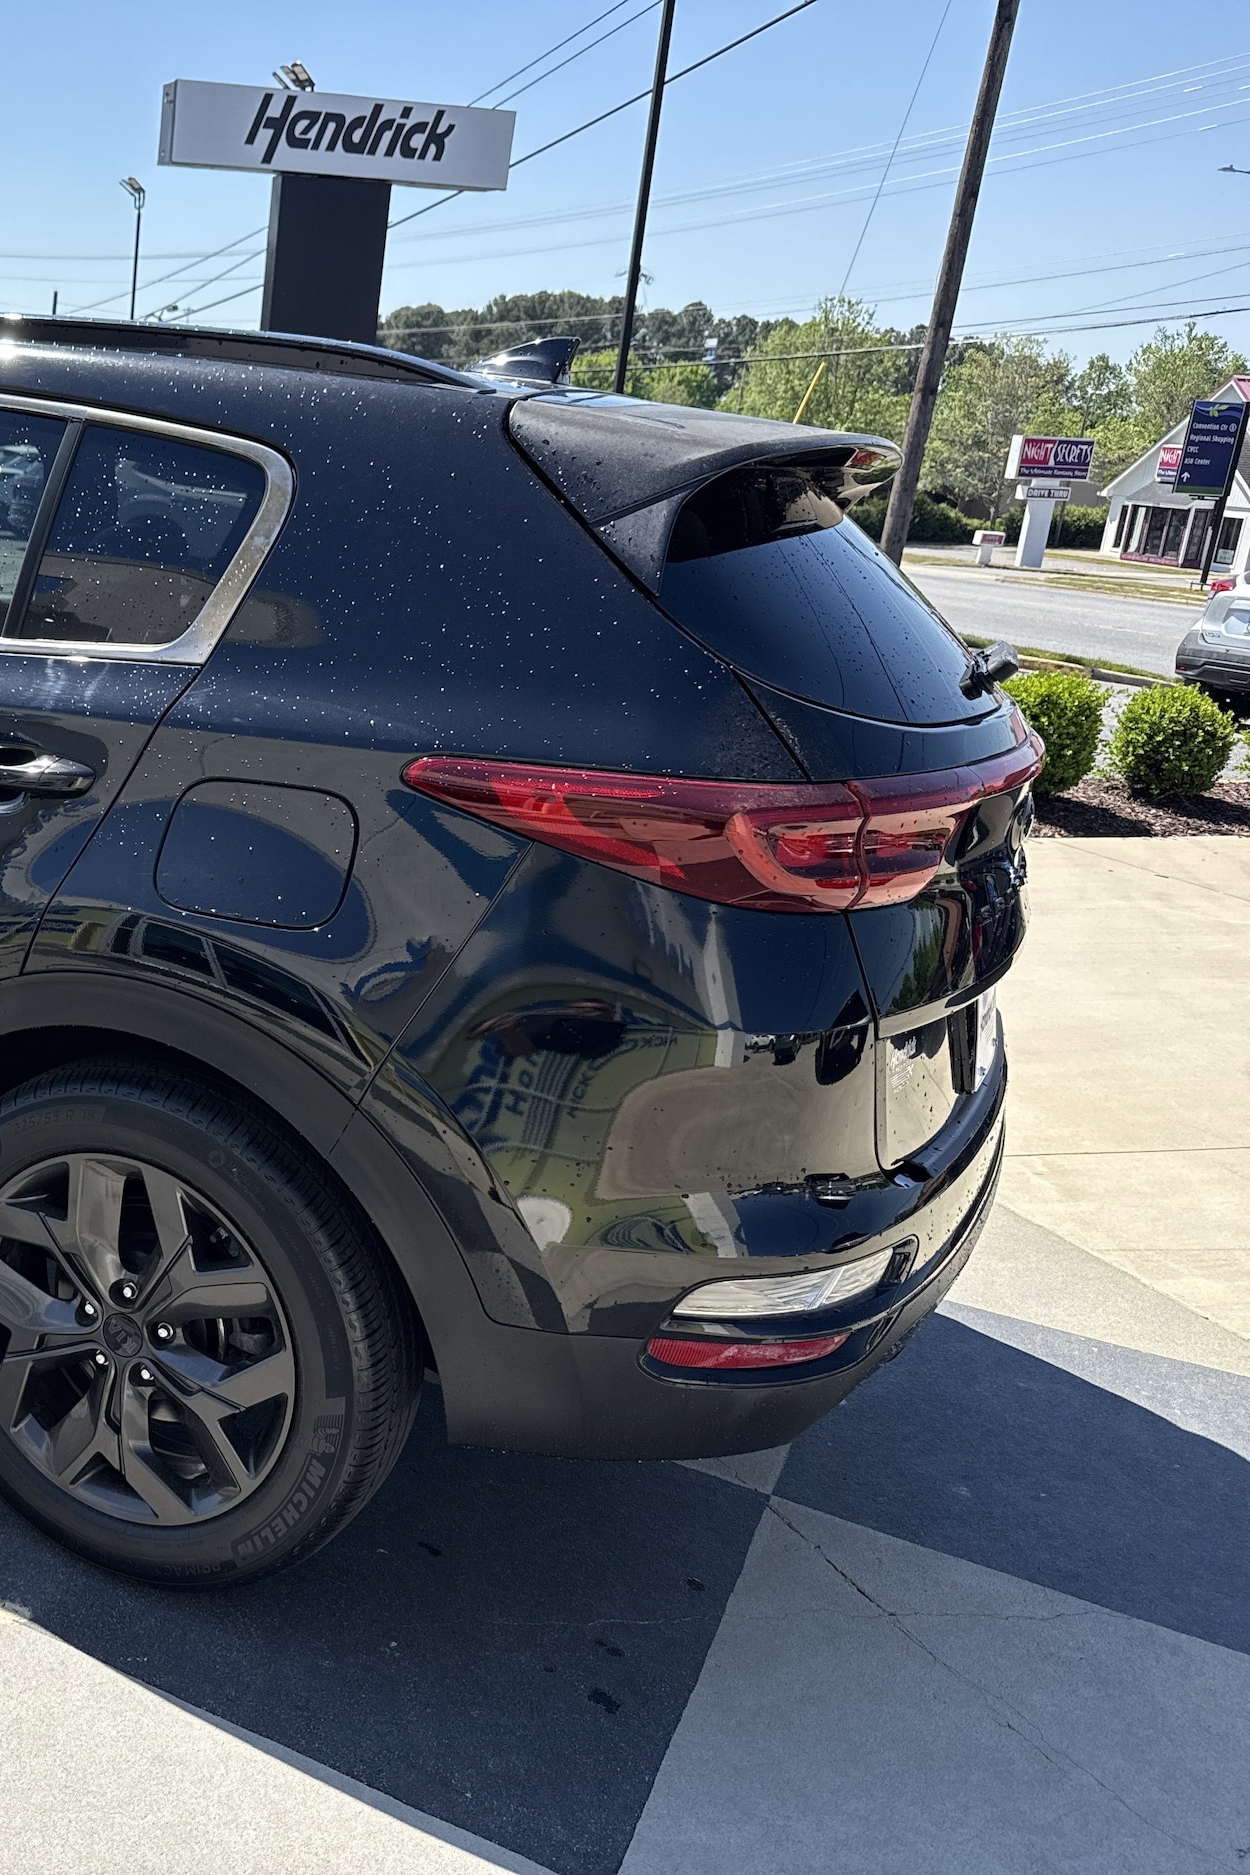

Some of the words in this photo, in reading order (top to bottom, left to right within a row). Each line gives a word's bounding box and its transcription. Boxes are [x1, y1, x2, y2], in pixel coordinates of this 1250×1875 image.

[244, 92, 456, 165] Hendrick
[1192, 422, 1220, 431] Convention
[1190, 433, 1211, 443] Regional
[1212, 435, 1235, 445] Shopping
[1056, 444, 1093, 464] SECRETS
[1027, 489, 1048, 497] DRIVE
[1050, 490, 1069, 498] THRU
[13, 1113, 60, 1136] 225/55
[65, 1111, 74, 1120] R
[237, 1458, 327, 1557] MICHELIN
